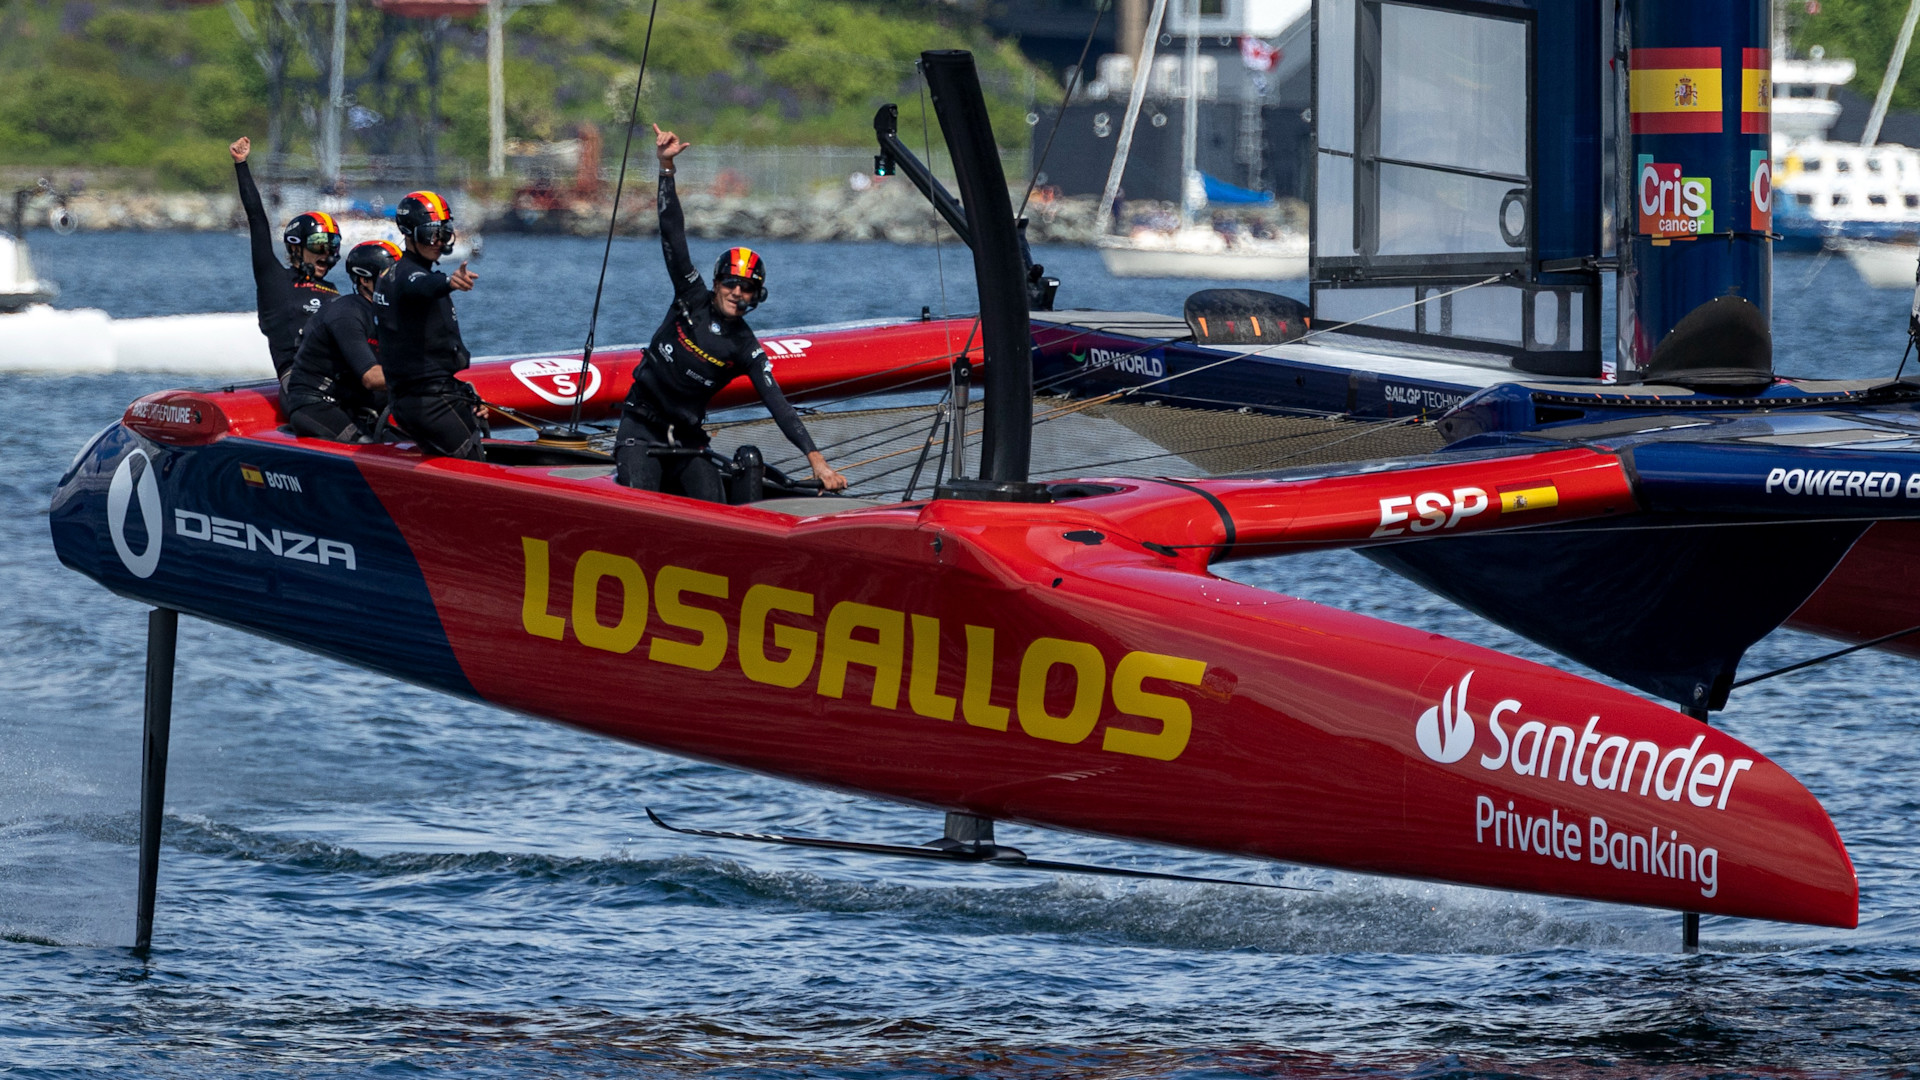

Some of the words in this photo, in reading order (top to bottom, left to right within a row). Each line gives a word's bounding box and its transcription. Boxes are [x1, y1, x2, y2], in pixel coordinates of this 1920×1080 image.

[1641, 166, 1707, 217] Cris
[1658, 219, 1706, 232] cancer
[1110, 351, 1163, 377] WORLD
[264, 471, 303, 493] BOTIN
[1766, 468, 1901, 498] POWERED
[1370, 487, 1489, 538] ESP
[174, 508, 357, 571] DENZA
[1480, 699, 1754, 810] Santander
[1476, 795, 1582, 861] Private
[1589, 816, 1719, 898] Banking
